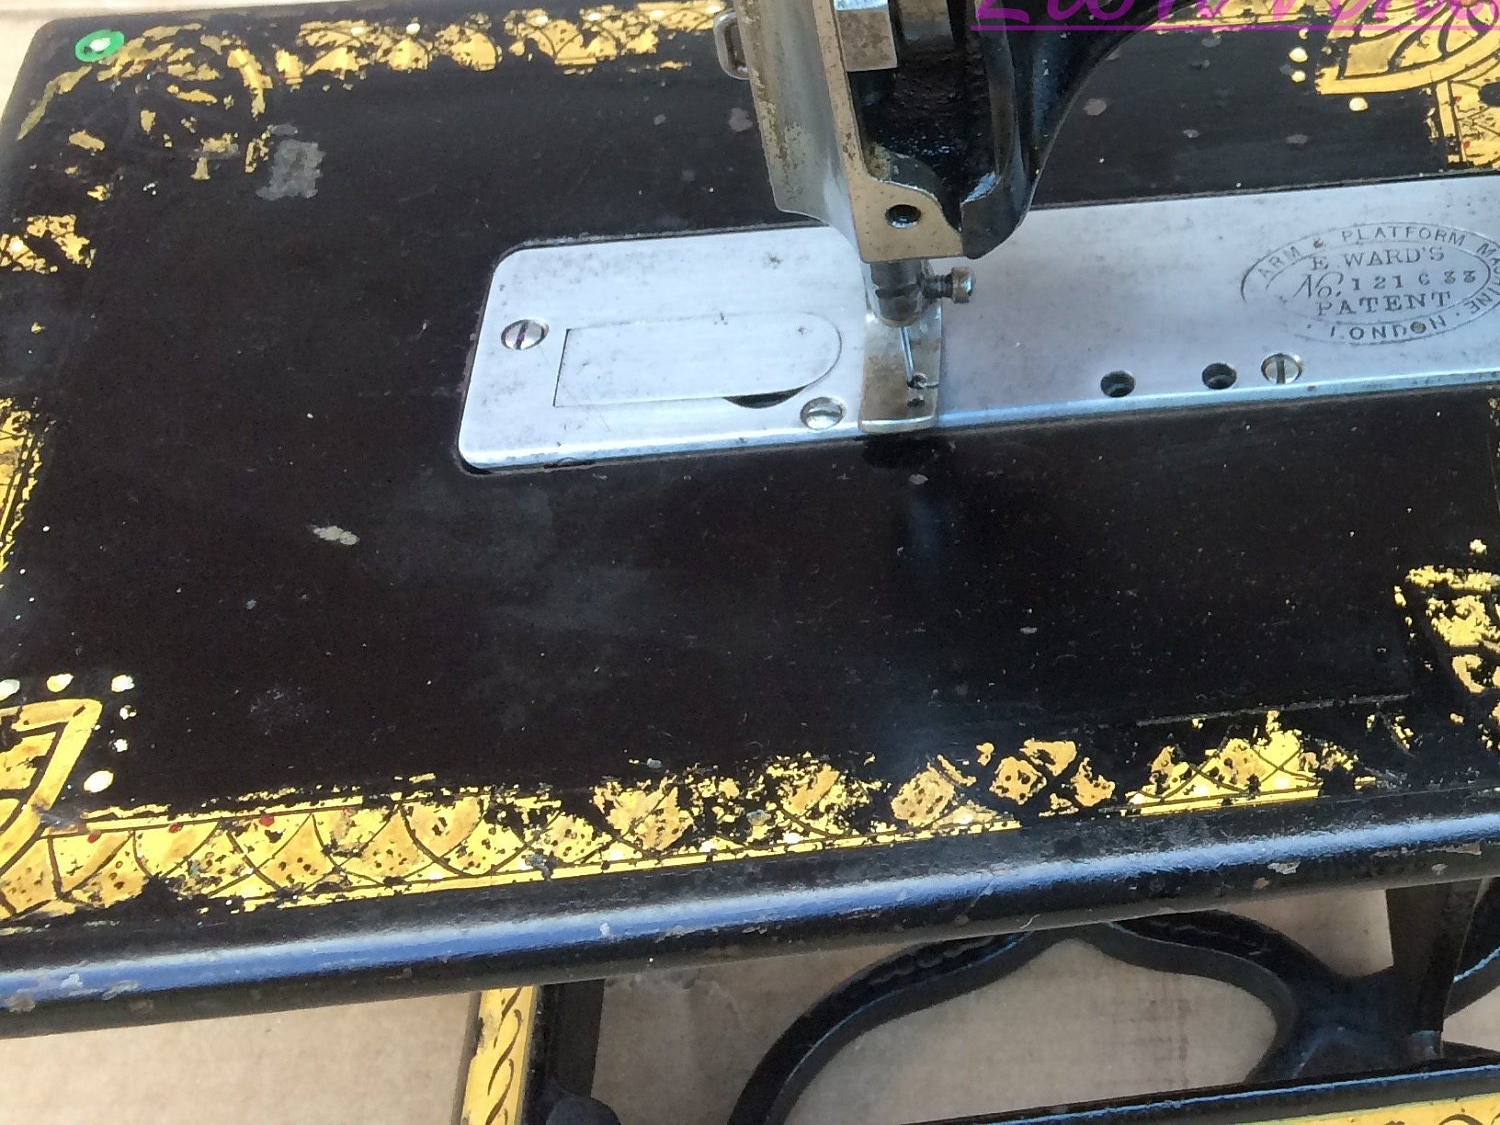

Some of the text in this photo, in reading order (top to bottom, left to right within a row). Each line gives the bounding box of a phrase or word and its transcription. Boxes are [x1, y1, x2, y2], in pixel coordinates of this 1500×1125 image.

[1341, 226, 1466, 247] PLATFORM
[1343, 246, 1445, 268] WARD'S
[1317, 291, 1451, 317] PATENT
[1330, 314, 1447, 340] LONDON
